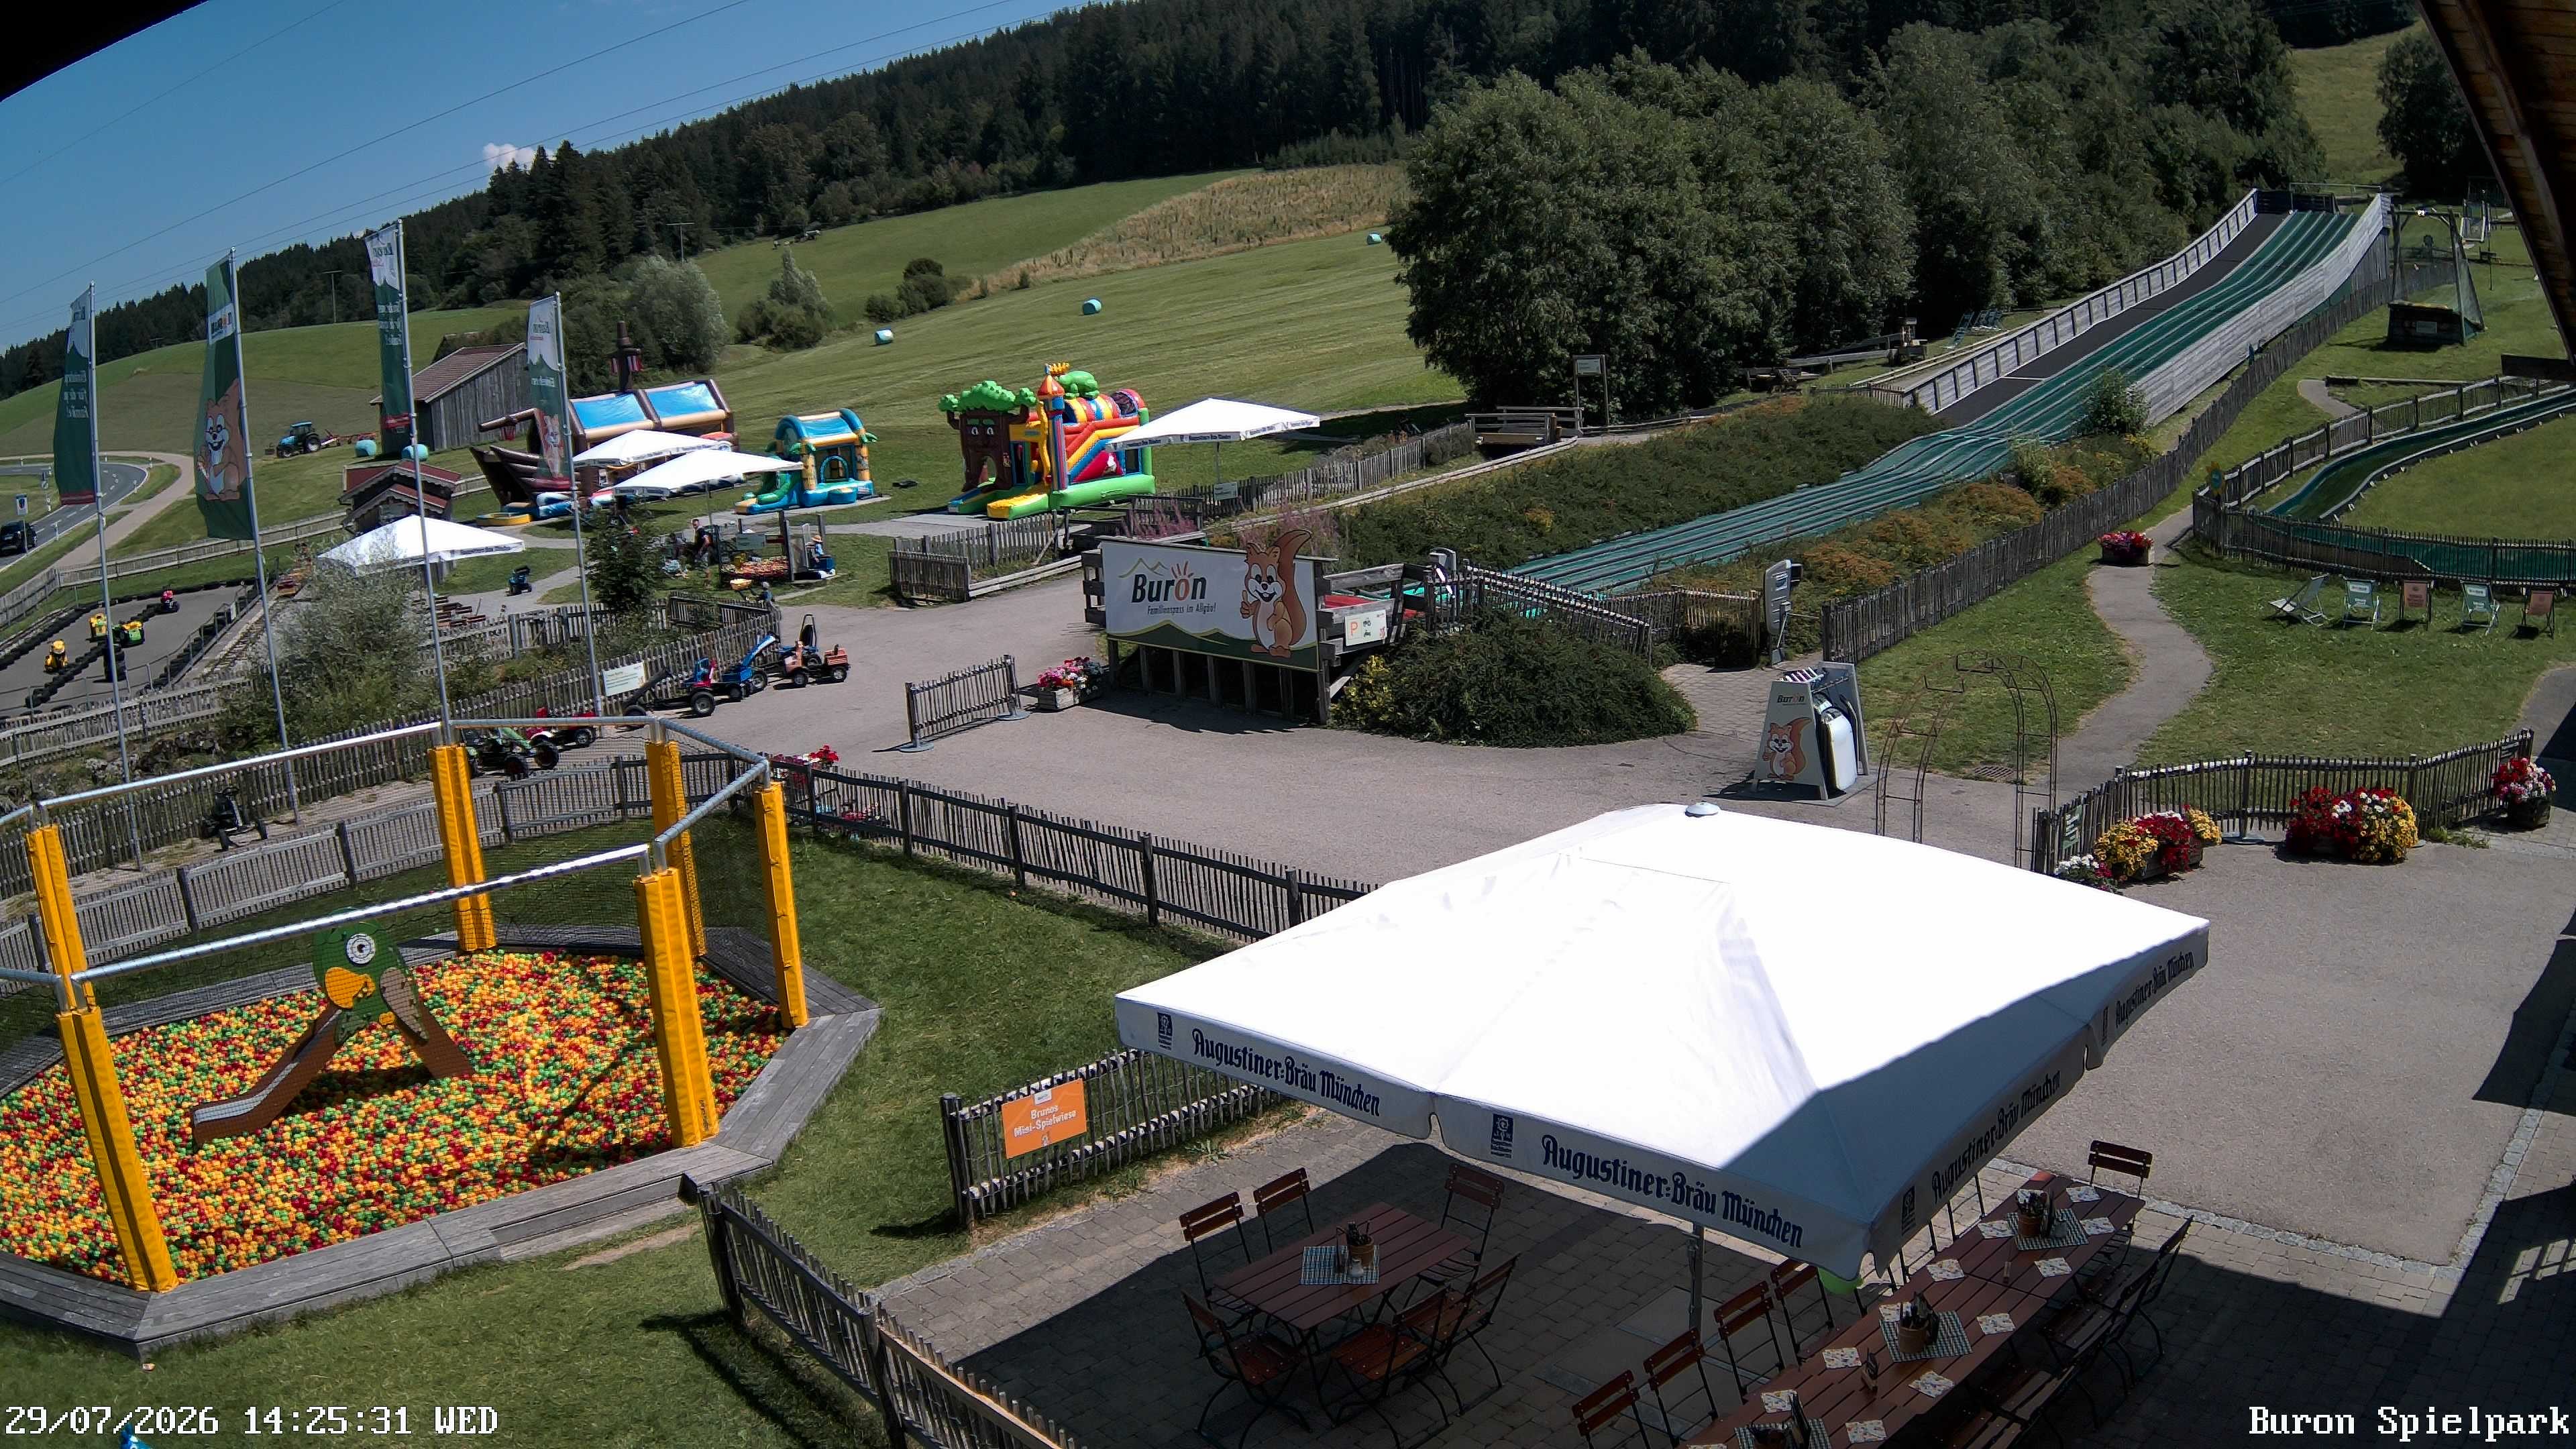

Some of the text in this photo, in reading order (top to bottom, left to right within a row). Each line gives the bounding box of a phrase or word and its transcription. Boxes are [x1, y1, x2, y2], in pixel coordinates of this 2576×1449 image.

[1131, 573, 1208, 603] Buron
[1320, 1069, 1381, 1118] München
[2021, 1070, 2061, 1119] München
[1721, 1189, 1805, 1248] München
